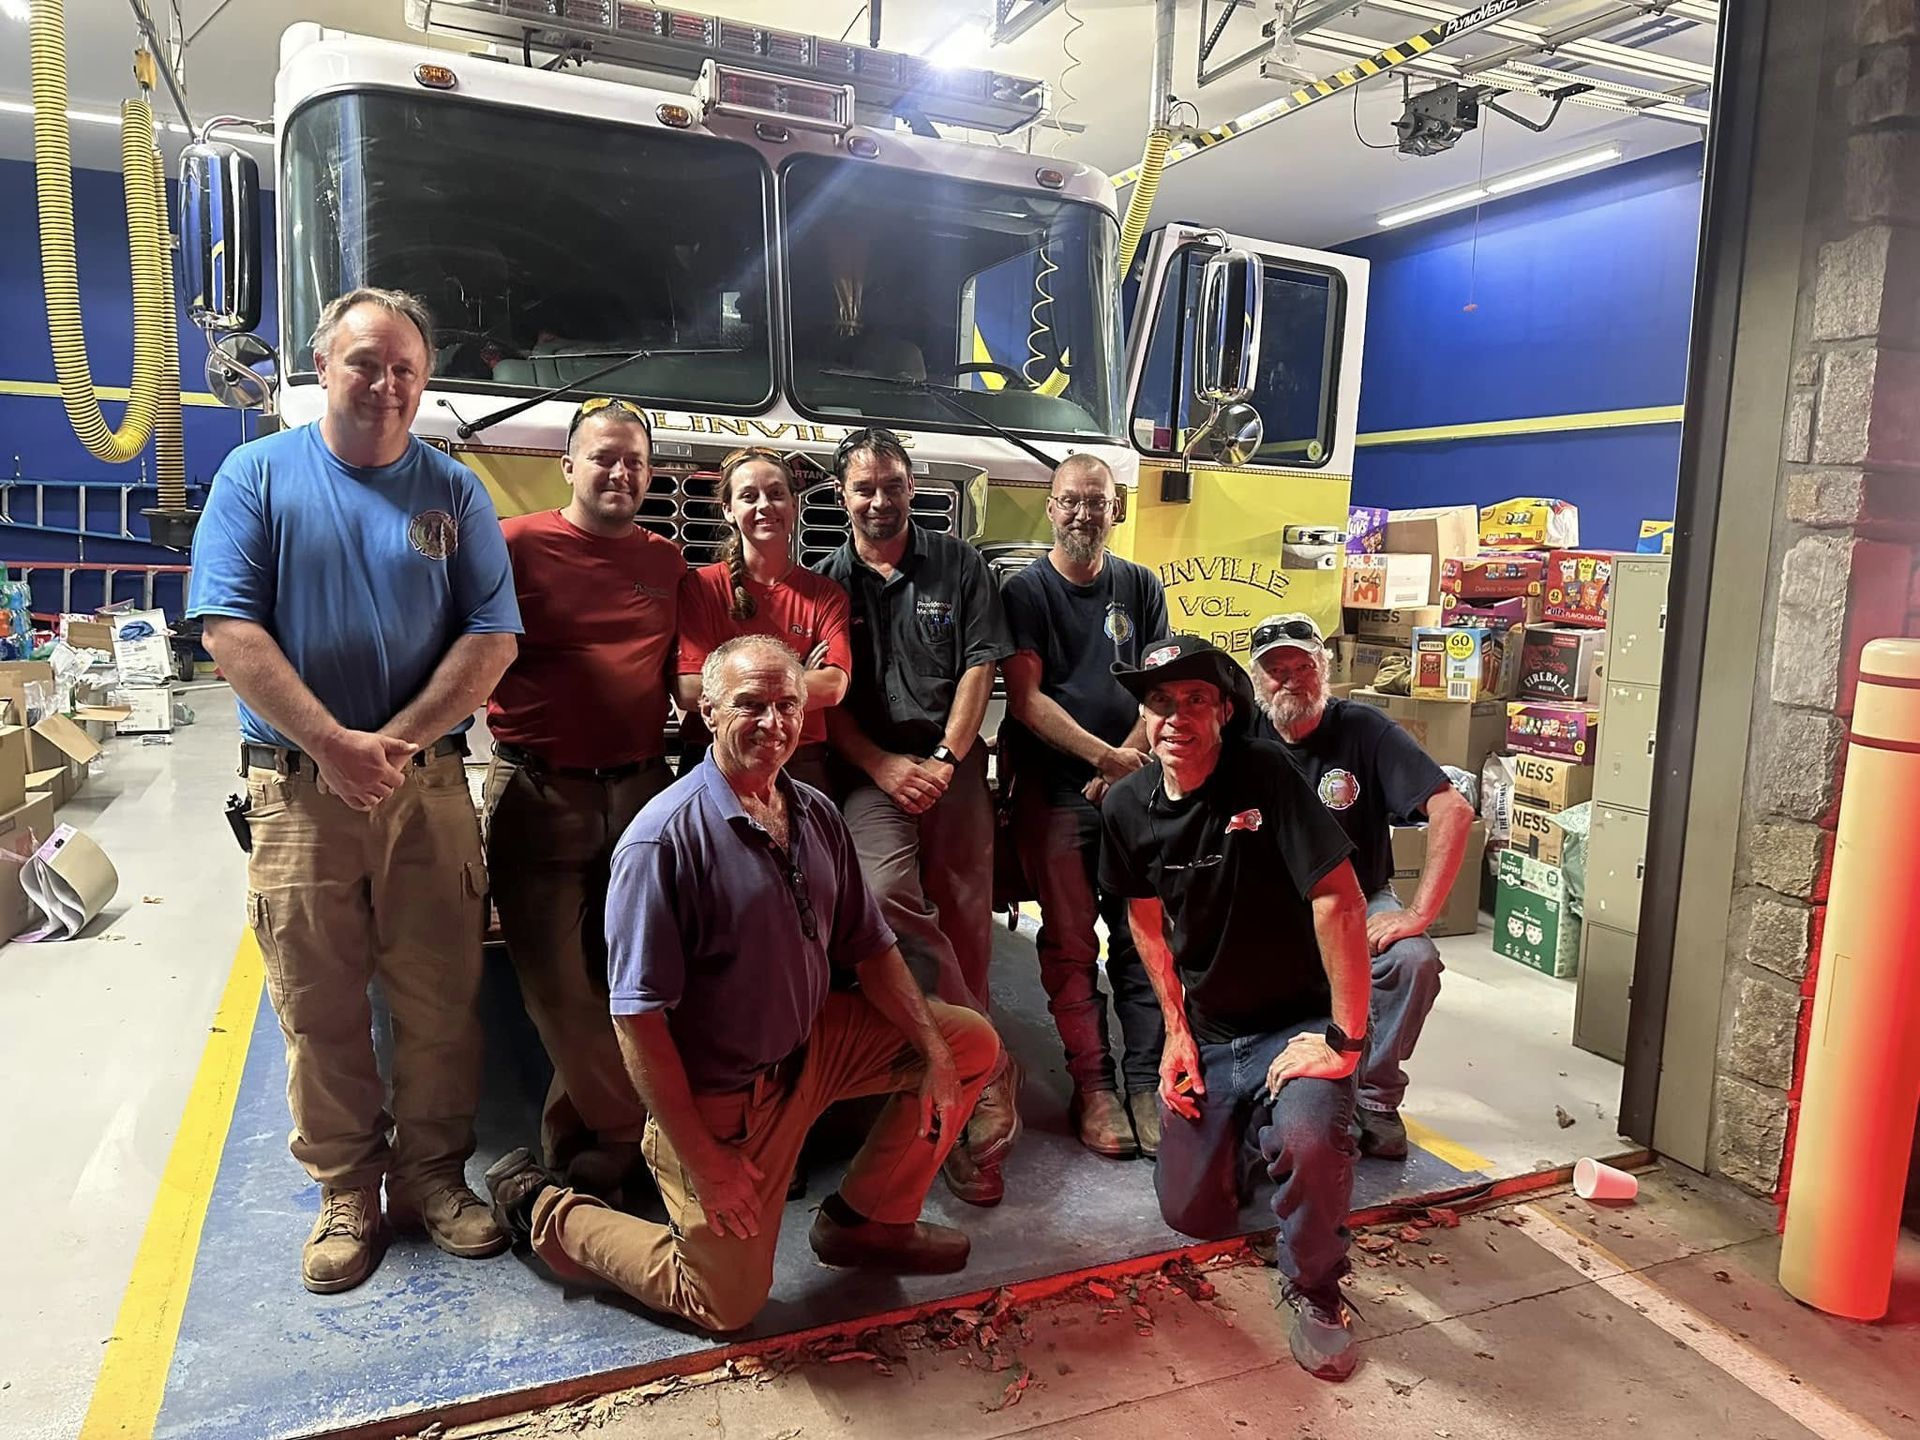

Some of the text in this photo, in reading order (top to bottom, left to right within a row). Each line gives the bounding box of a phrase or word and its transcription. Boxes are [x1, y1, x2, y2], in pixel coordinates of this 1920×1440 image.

[651, 412, 916, 449] LINVILE
[1160, 556, 1290, 599] INVILLE
[1178, 596, 1251, 617] VOL.
[1451, 634, 1470, 647] 60
[1523, 671, 1571, 696] FIREBALL
[1515, 759, 1555, 783] NESS
[1498, 782, 1508, 830] THE ORIGINAL
[1512, 808, 1551, 834] NESS
